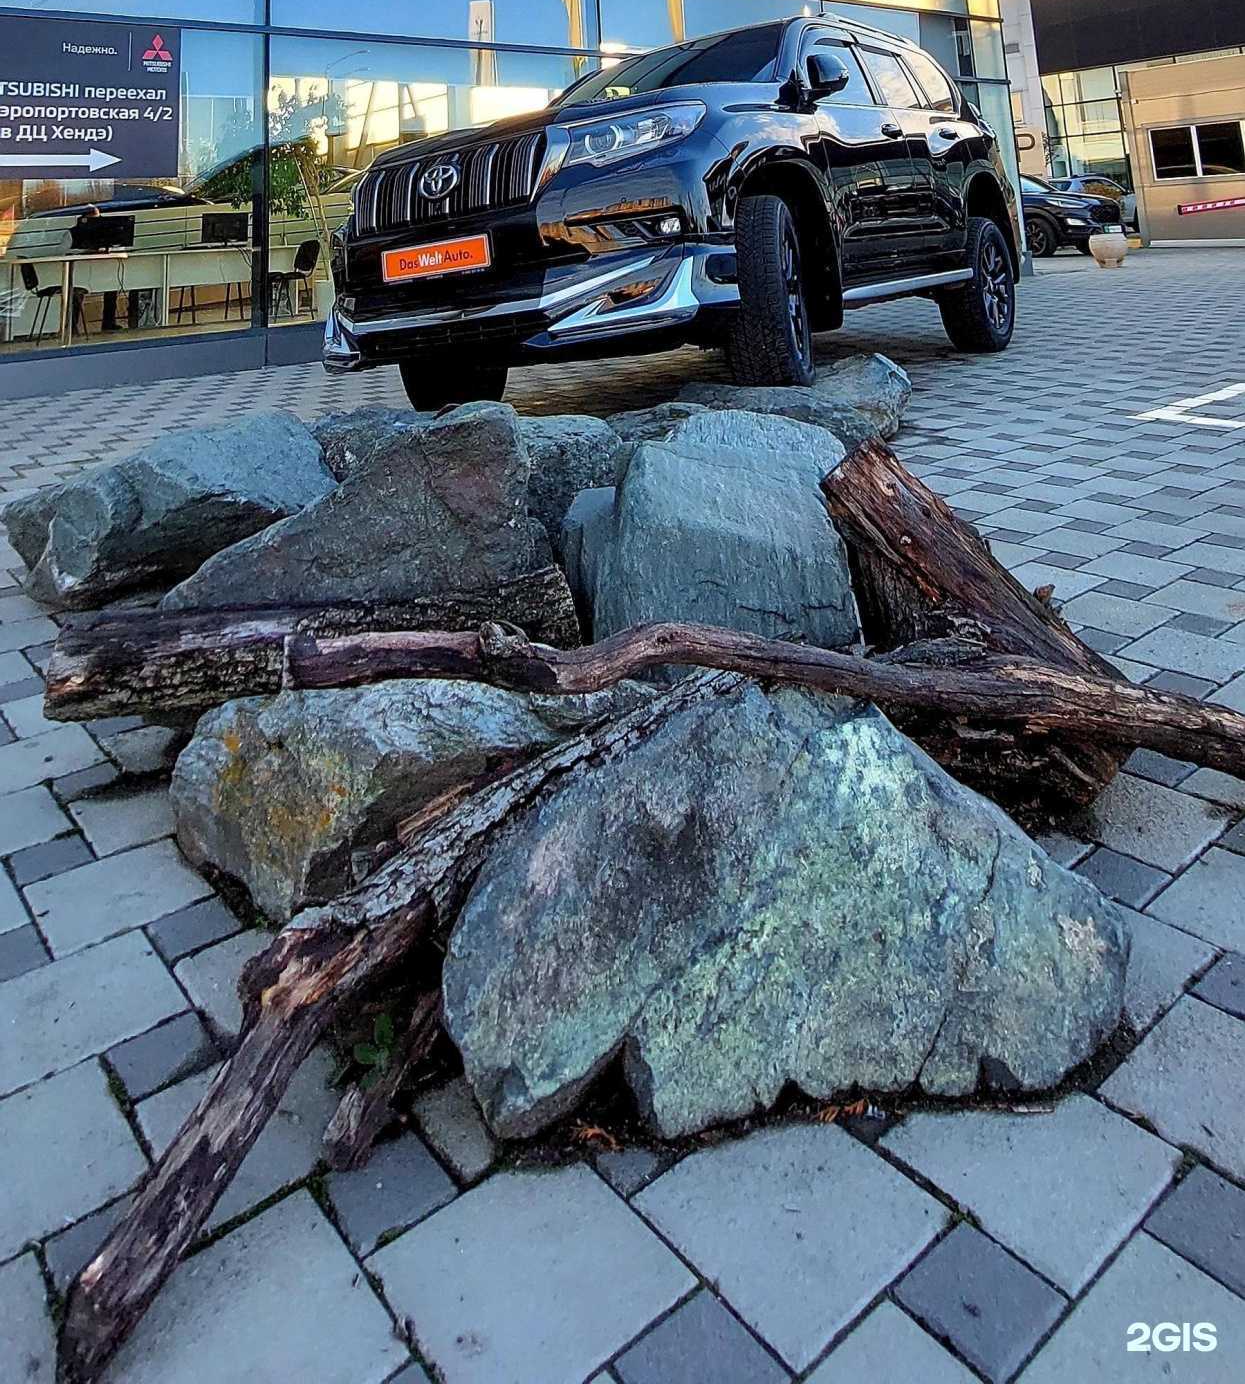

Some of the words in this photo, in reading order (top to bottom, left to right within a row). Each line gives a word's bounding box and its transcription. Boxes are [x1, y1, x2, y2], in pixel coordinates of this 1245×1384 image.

[62, 43, 118, 55] Надежно.
[84, 87, 166, 100] переехал
[143, 107, 173, 121] 4/2
[15, 125, 47, 141] ДЦ
[51, 125, 113, 141] Хендэ)
